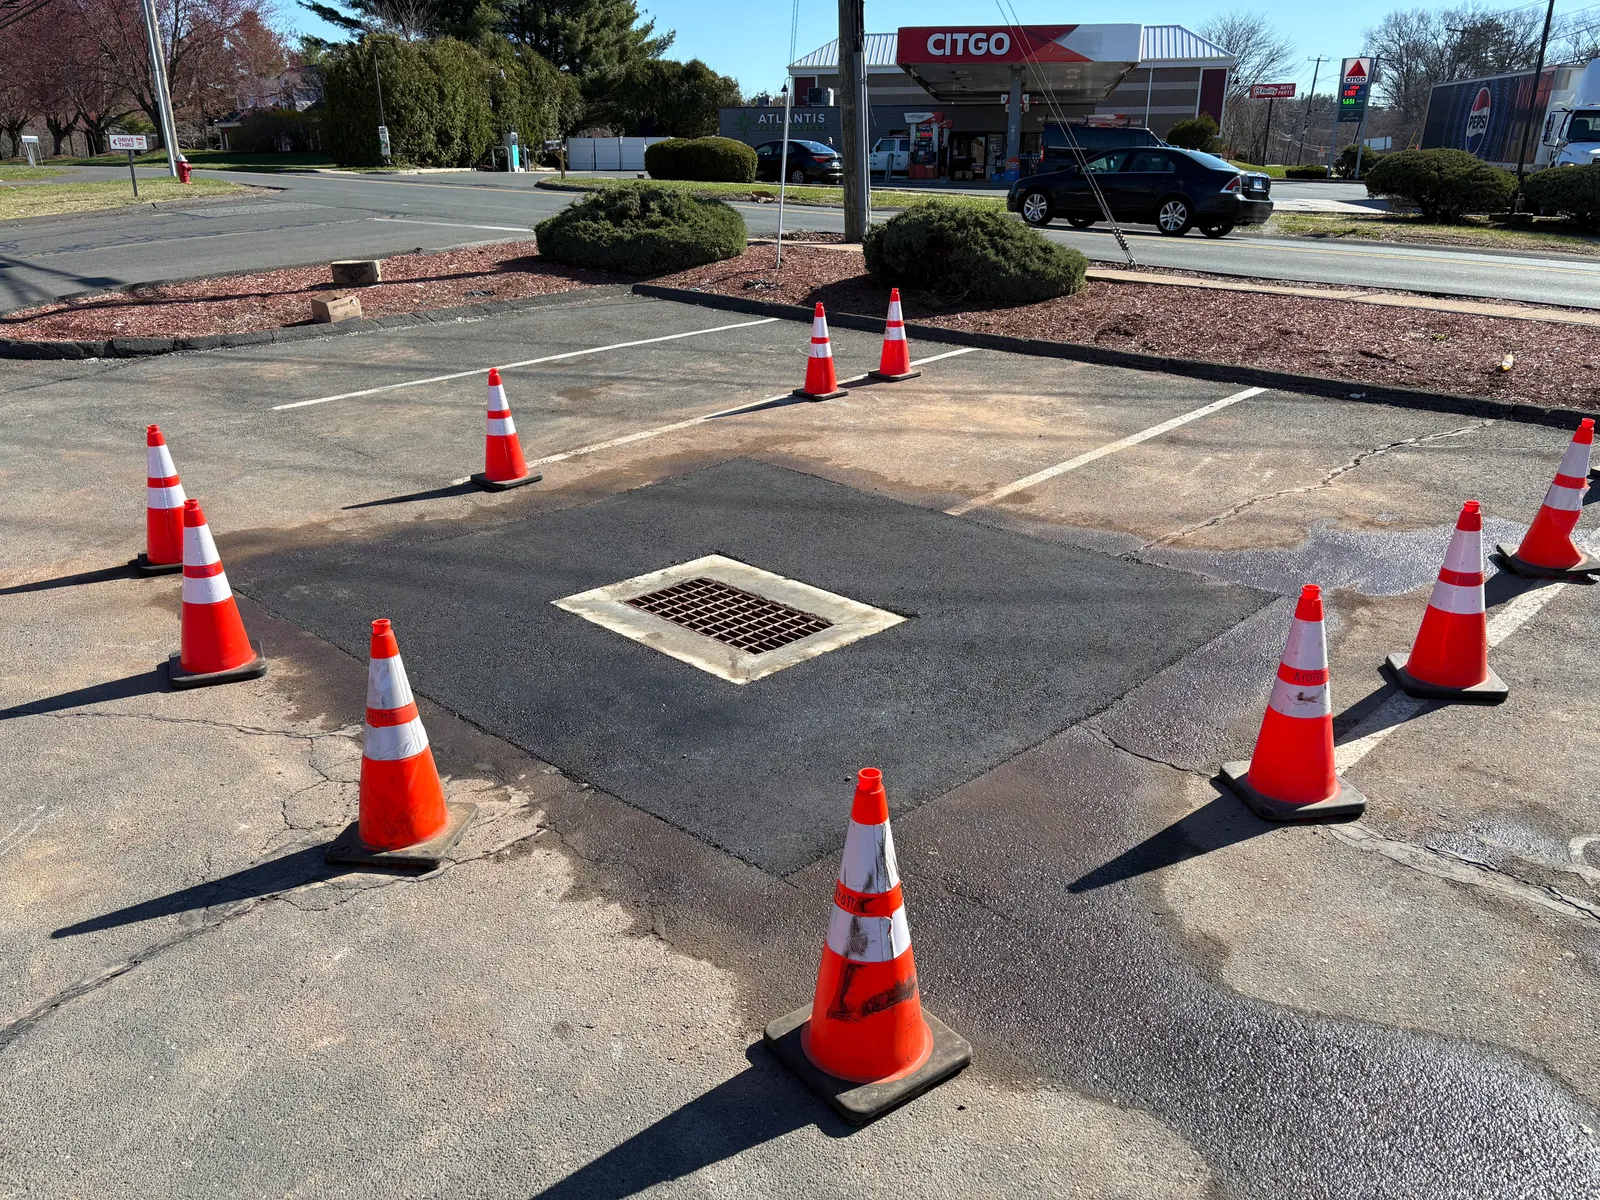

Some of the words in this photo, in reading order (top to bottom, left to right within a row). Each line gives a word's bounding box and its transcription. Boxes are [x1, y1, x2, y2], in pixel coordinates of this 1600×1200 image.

[927, 32, 1010, 56] CITGO
[758, 113, 826, 124] ATLANTIS
[1468, 115, 1487, 129] PEPSI
